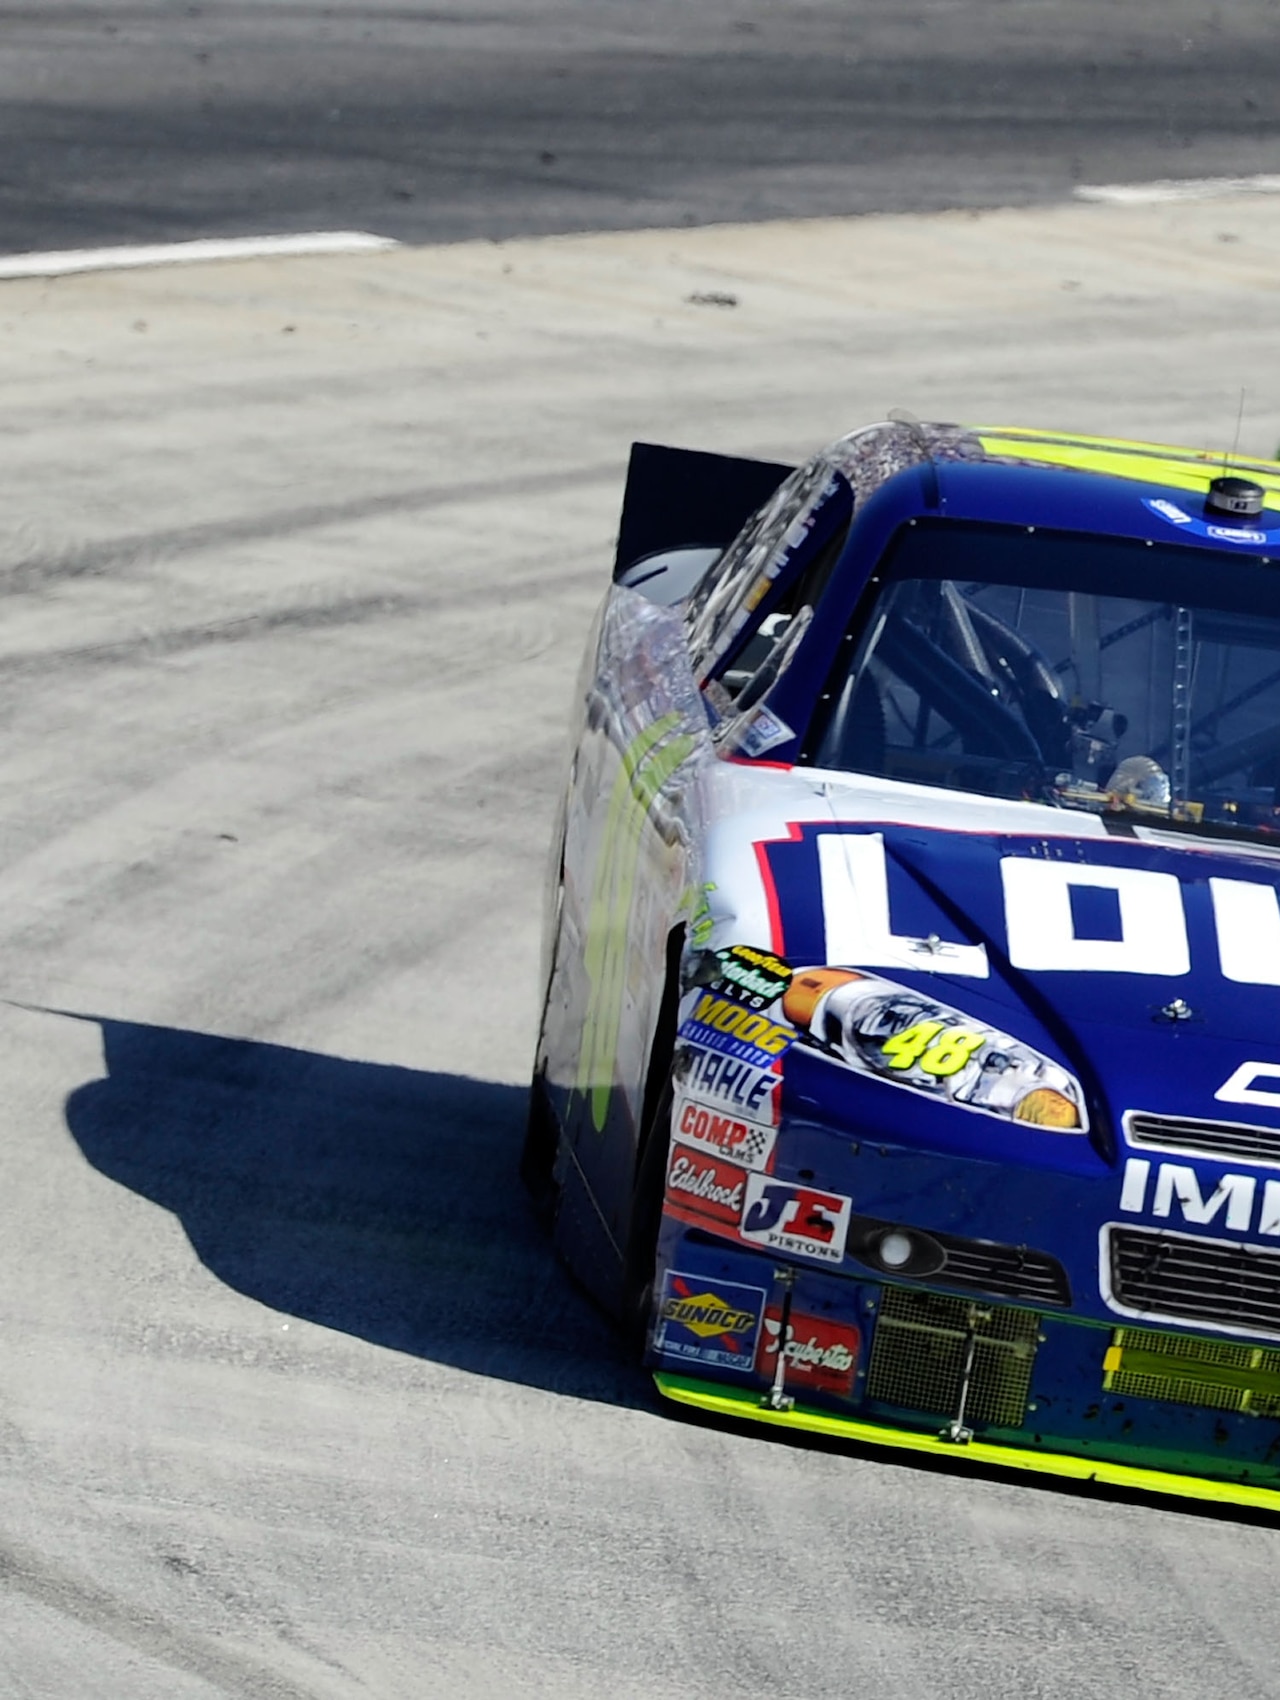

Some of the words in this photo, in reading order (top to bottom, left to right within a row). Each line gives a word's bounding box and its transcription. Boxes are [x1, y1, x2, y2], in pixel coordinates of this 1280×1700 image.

[694, 994, 798, 1054] MOOG
[882, 1020, 986, 1076] 48
[680, 1105, 747, 1148] COMP
[719, 1145, 756, 1164] CAMS
[667, 1157, 745, 1212] Edelbrock
[743, 1184, 844, 1244] JE
[768, 1233, 840, 1259] PISTONS
[664, 1299, 753, 1330] SUNOCO
